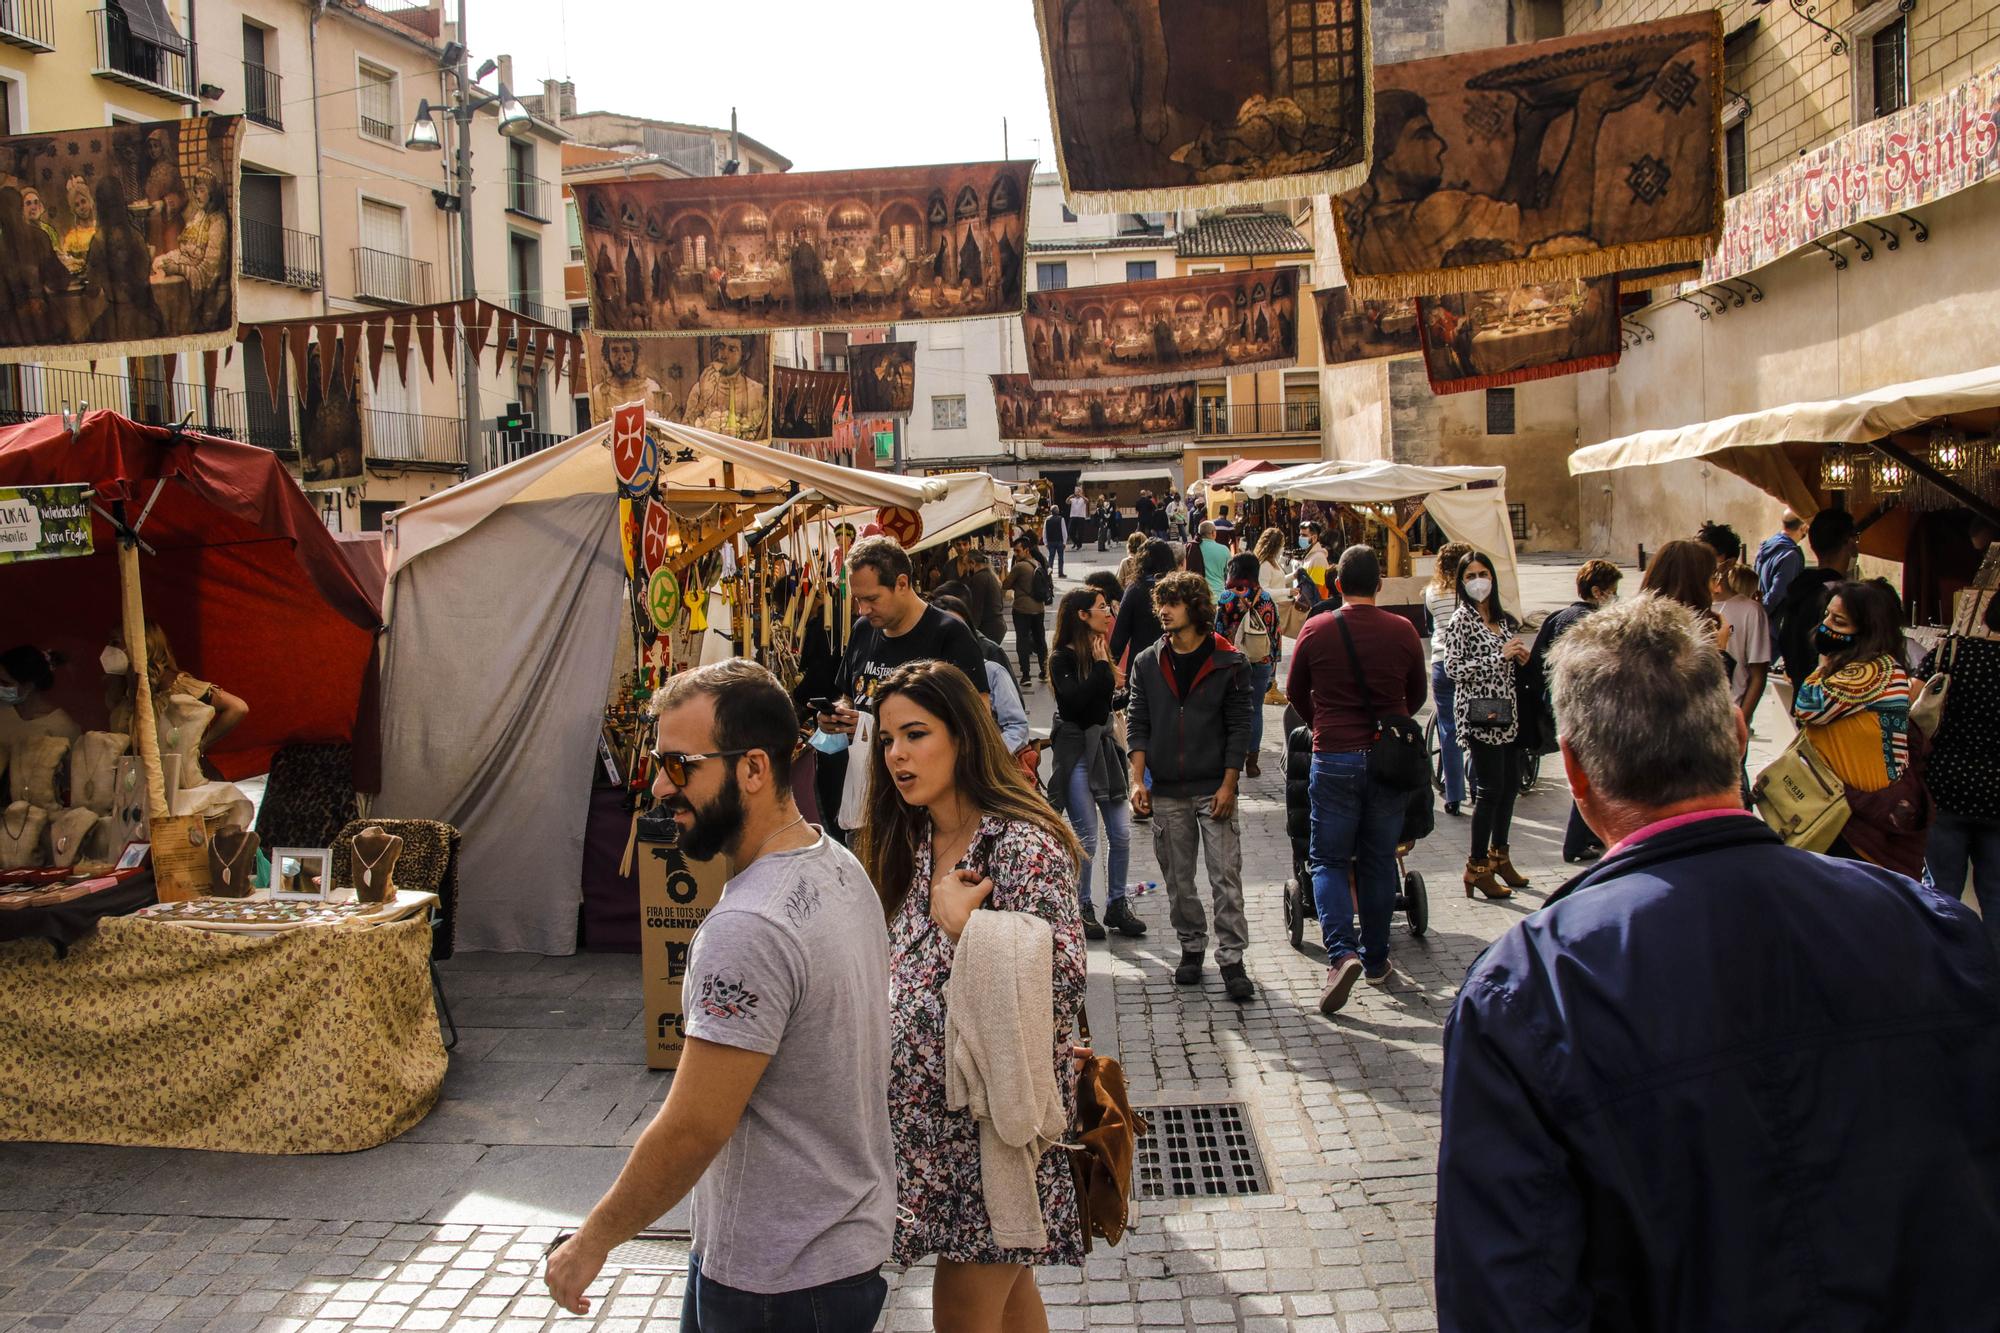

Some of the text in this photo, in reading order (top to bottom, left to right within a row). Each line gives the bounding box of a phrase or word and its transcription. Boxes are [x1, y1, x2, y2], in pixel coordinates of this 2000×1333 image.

[1763, 191, 1790, 246] de
[1803, 158, 1869, 222] Tots
[1885, 107, 1998, 194] Sants
[647, 906, 663, 918] FIRA
[665, 907, 675, 918] DE
[677, 908, 694, 918] TOTS
[702, 982, 712, 996] 19
[735, 990, 759, 1008] 72
